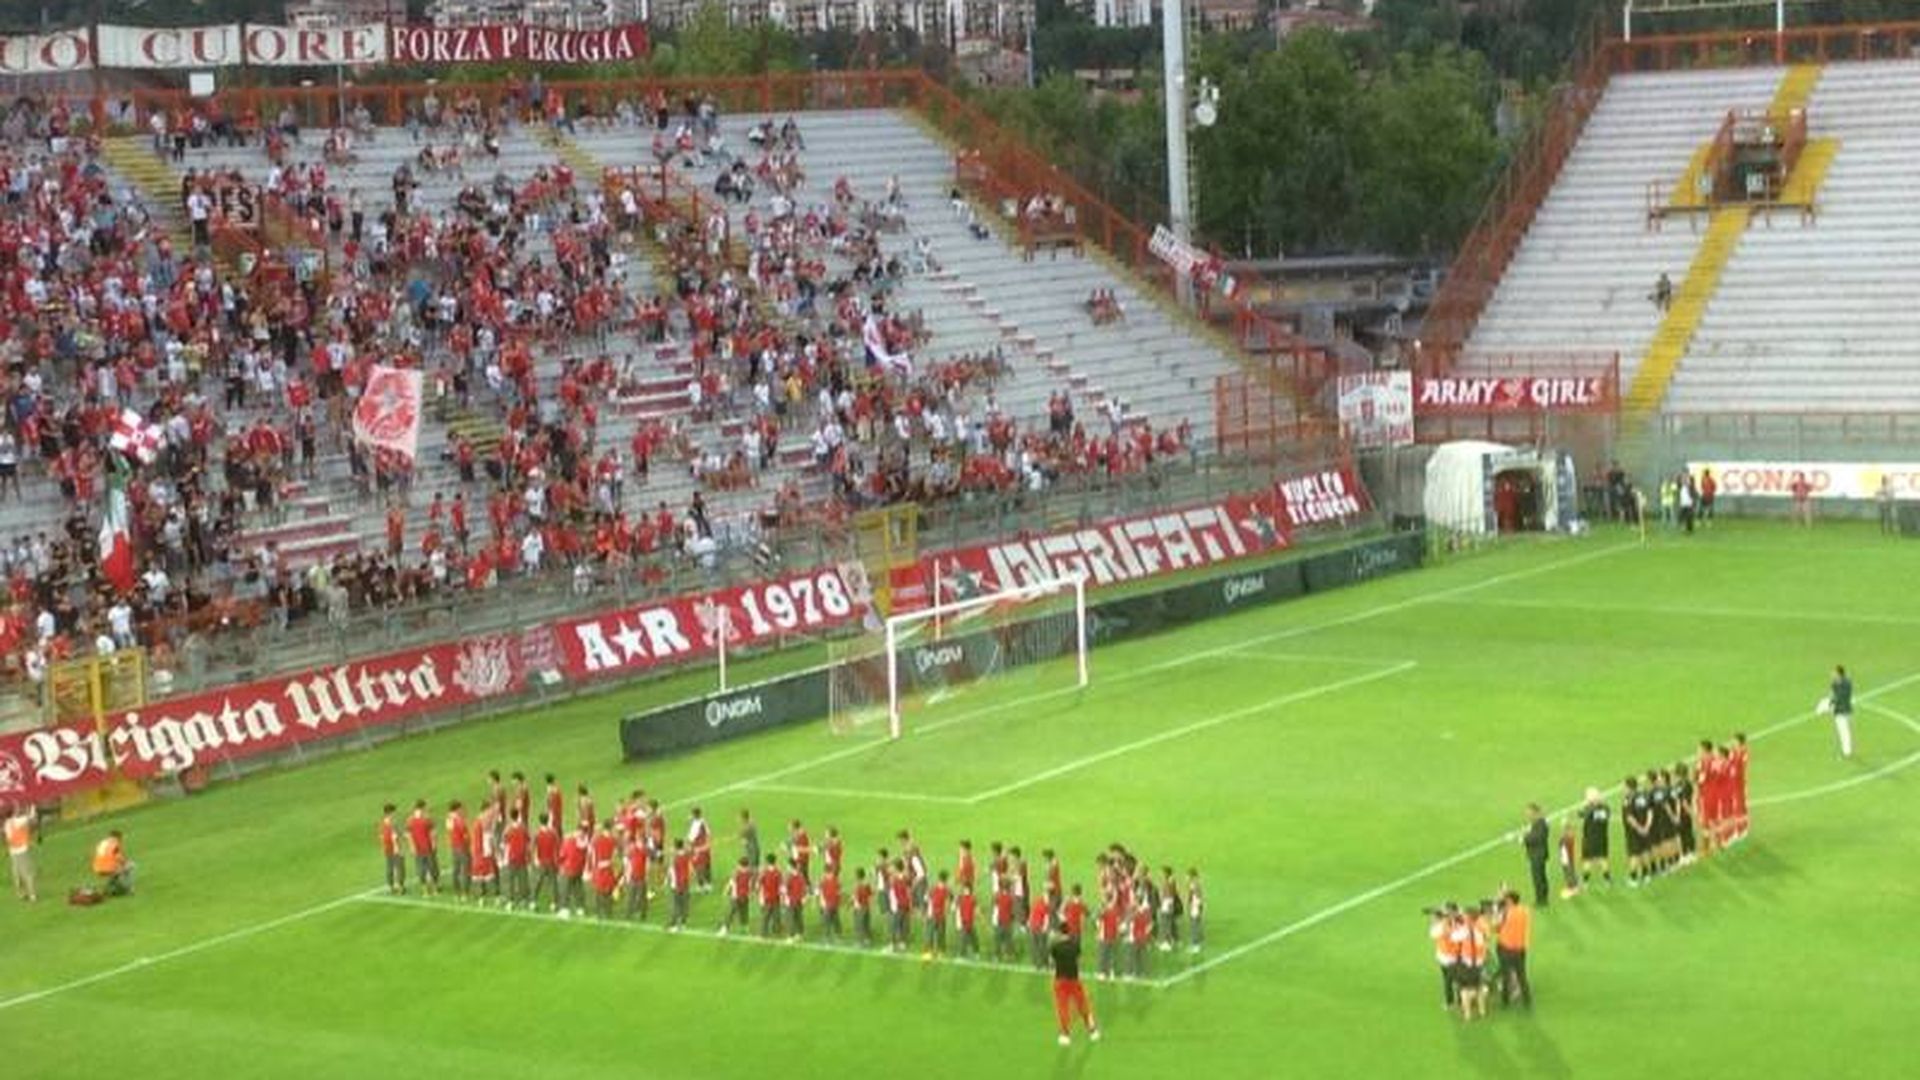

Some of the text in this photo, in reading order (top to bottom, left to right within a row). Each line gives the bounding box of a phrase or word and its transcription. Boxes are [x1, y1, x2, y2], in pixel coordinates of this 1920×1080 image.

[142, 26, 376, 64] CUORE
[393, 23, 634, 62] FORZA PERUGIA
[1421, 378, 1498, 405] ARMY
[740, 570, 850, 636] 1978
[23, 697, 286, 783] Brigata
